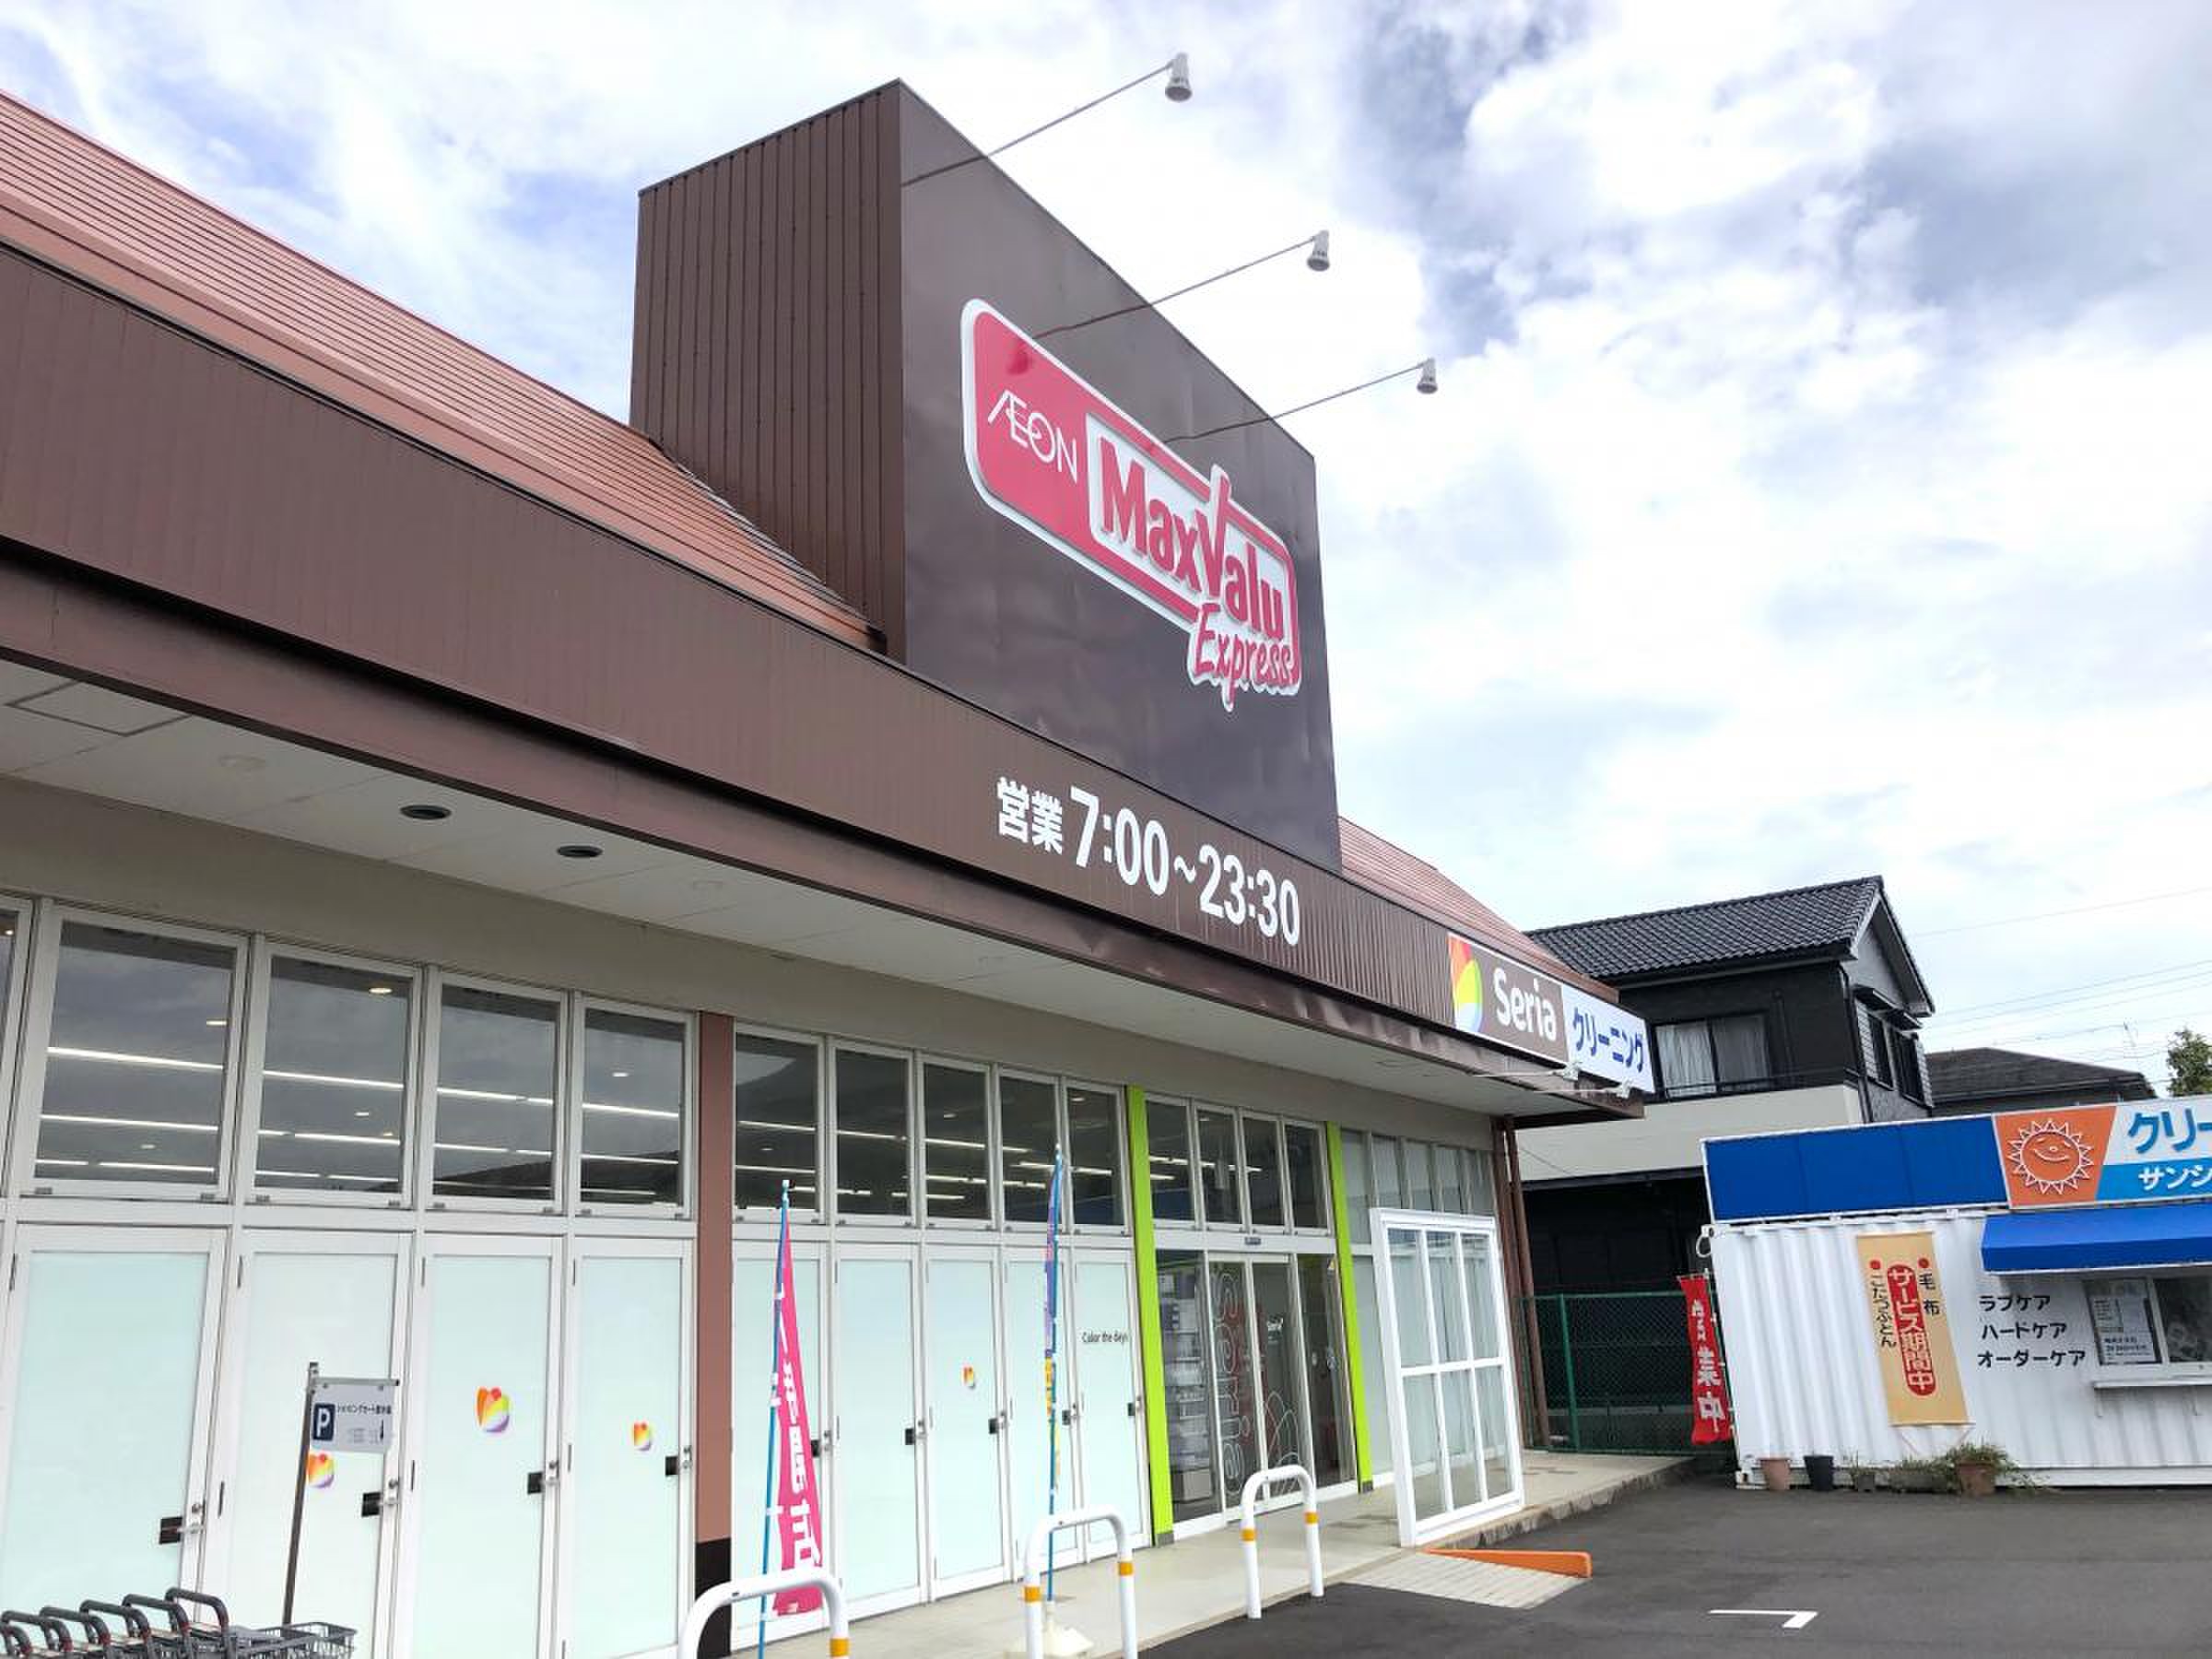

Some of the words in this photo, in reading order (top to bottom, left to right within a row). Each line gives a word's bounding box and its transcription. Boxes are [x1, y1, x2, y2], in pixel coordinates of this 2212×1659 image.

[1194, 602, 1295, 708] Express
[997, 777, 1062, 854] 営業
[1493, 968, 1557, 1041] Seria
[1572, 1006, 1644, 1073] クリーニング
[1919, 1272, 1940, 1315] 毛布
[1977, 1349, 2086, 1368] オーダーケア
[1982, 1322, 2067, 1340] ハードケア
[316, 1407, 331, 1437] P
